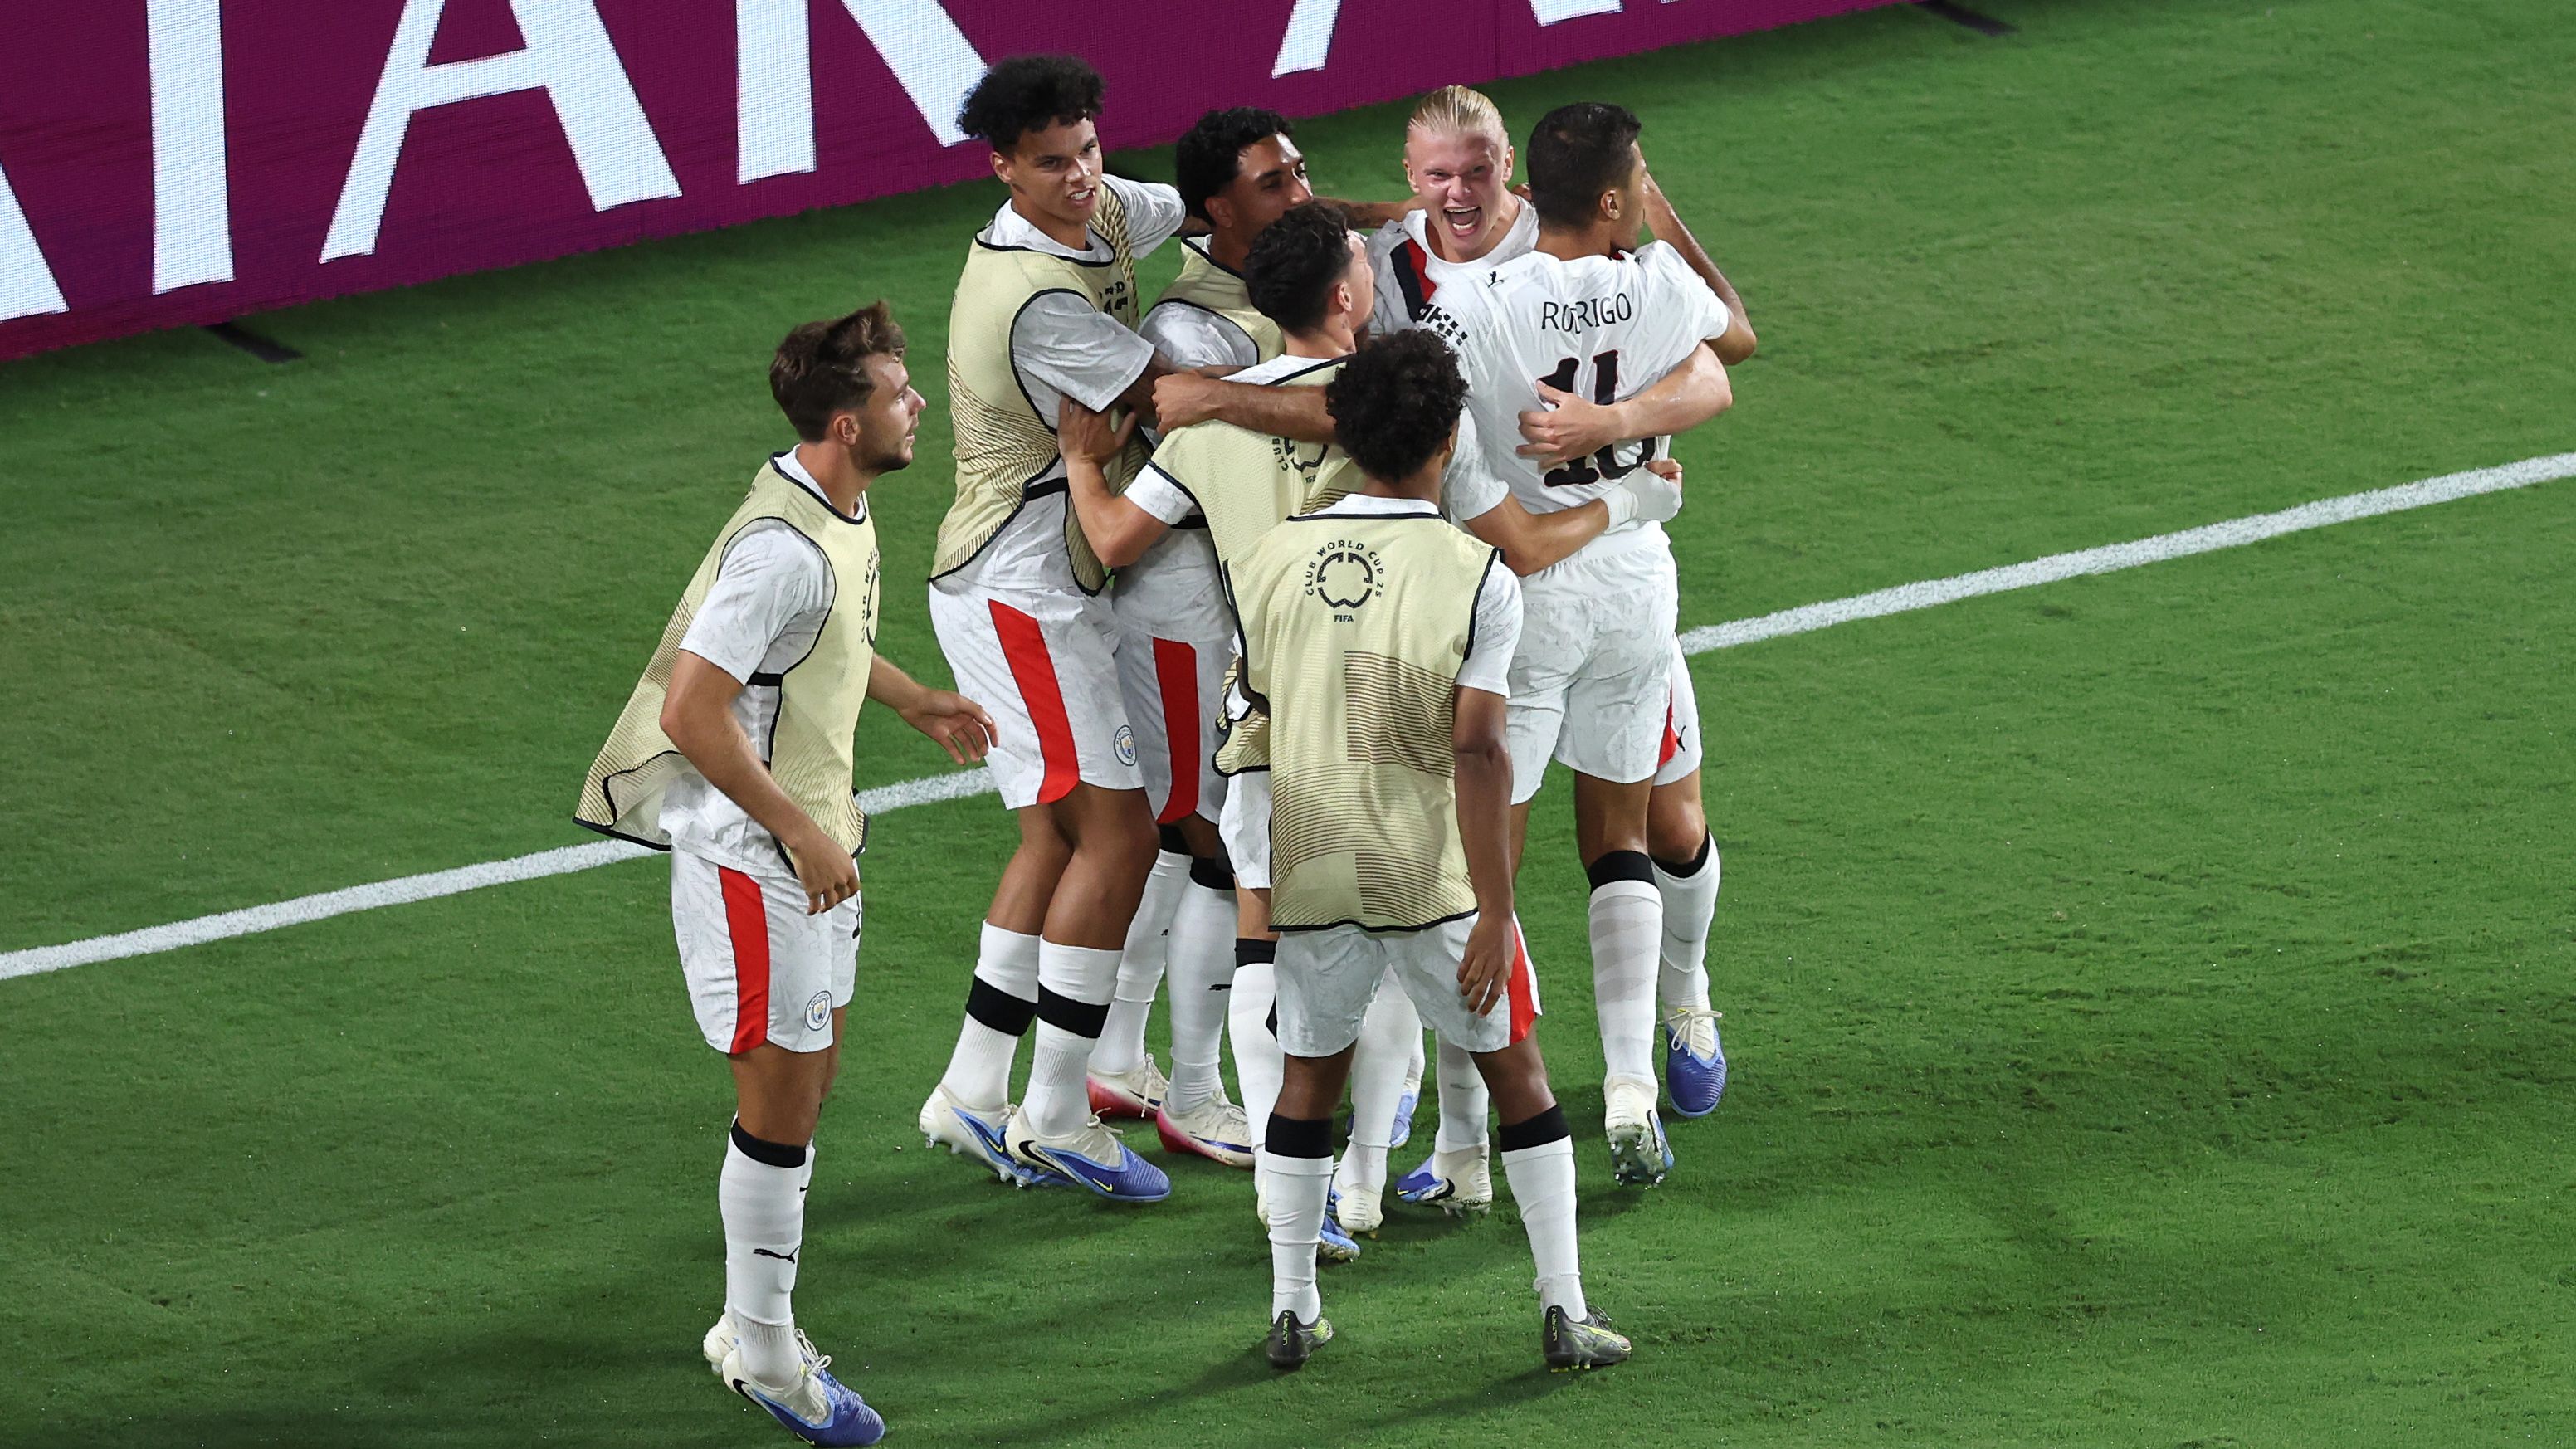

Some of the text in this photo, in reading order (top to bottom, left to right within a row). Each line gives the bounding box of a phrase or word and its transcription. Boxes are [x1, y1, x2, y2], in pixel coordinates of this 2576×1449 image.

[1541, 292, 1632, 334] RORIGO
[1271, 437, 1289, 471] CLUB
[1305, 539, 1384, 598] CLUB WORLD CUP 25
[1334, 614, 1354, 622] FIFA
